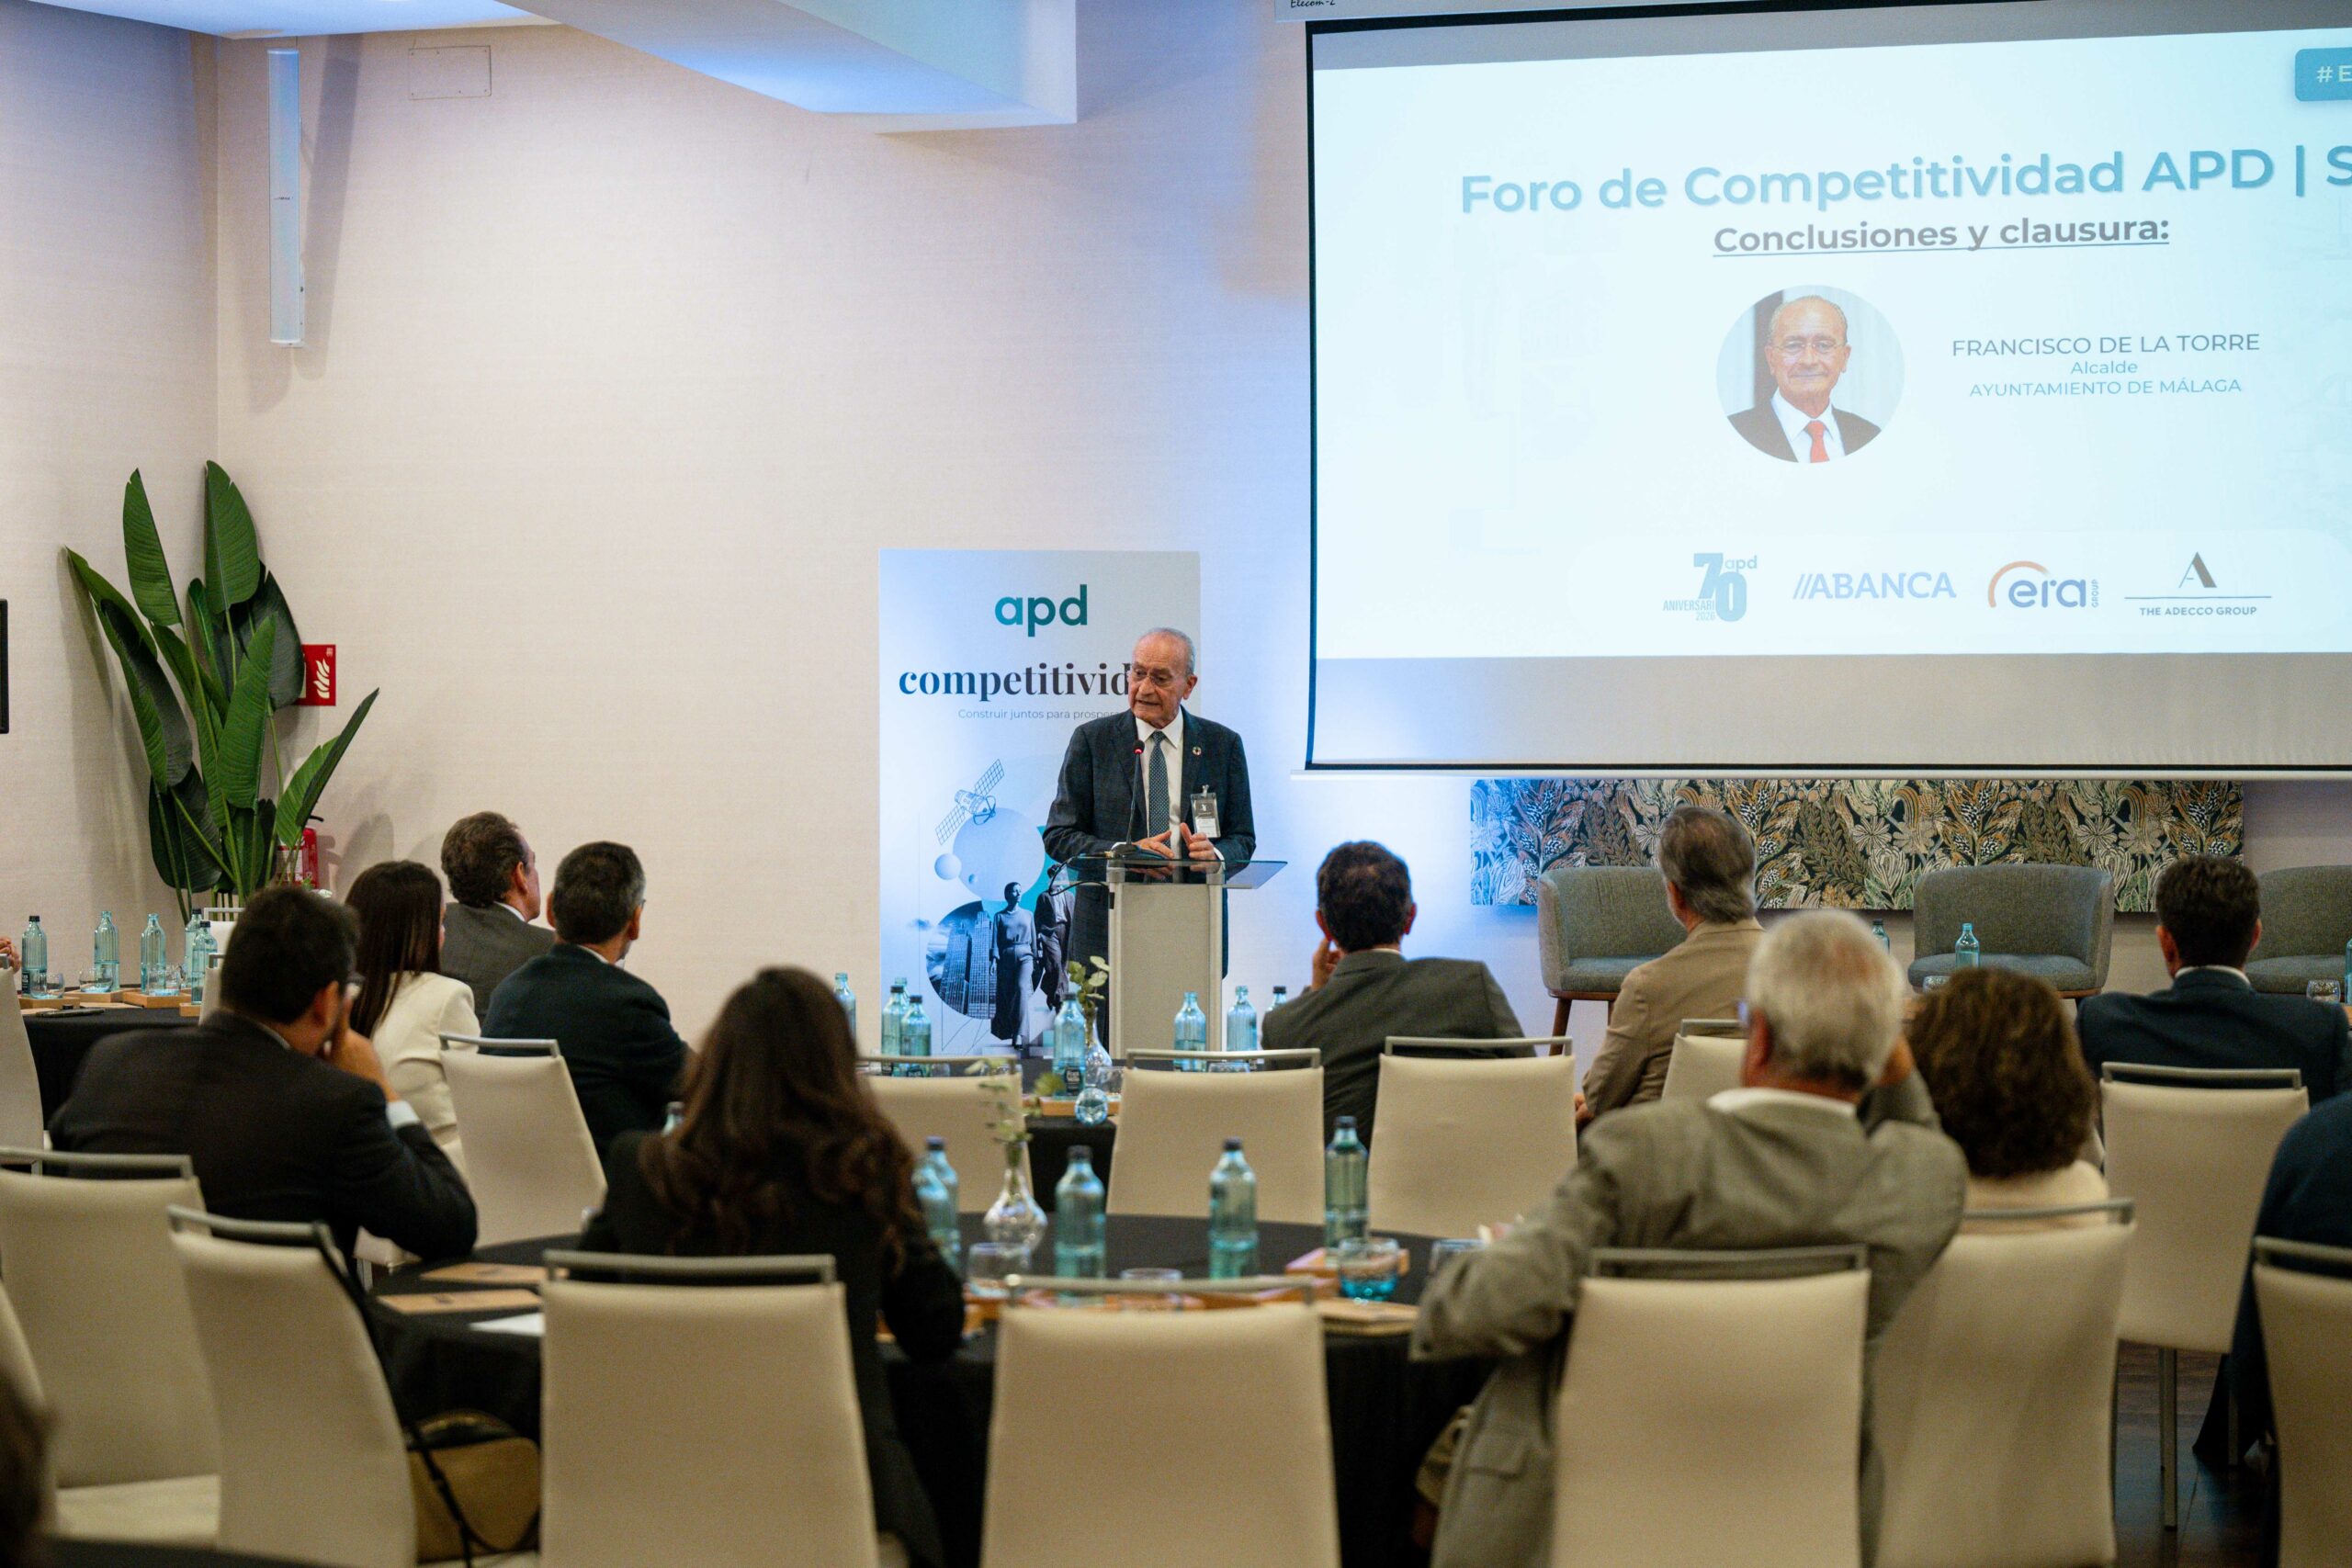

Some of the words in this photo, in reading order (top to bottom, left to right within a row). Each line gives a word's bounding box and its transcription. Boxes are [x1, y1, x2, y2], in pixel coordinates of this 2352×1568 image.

[1462, 175, 1583, 214] Foro
[1599, 167, 1668, 209] de
[1684, 150, 2124, 212] Competitividad
[2141, 148, 2275, 192] APD
[1713, 220, 1957, 253] Conclusiones
[1967, 225, 1990, 251] y
[1999, 217, 2170, 244] clausura:
[1952, 337, 2092, 356] FRANCISCO
[2099, 336, 2132, 354] DE
[2141, 335, 2171, 353] LA
[2177, 333, 2260, 352] TORRE
[2070, 360, 2139, 375] Alcalde
[1969, 380, 2122, 397] AYUNTAMIENTO
[2127, 380, 2154, 394] DE
[2160, 377, 2243, 394] MÁLAGA
[1724, 555, 1758, 572] apd
[2007, 579, 2086, 608] era
[994, 583, 1088, 637] apd
[2139, 606, 2162, 616] THE
[2164, 606, 2214, 616] ADECCO
[2215, 606, 2257, 616] GROUP
[899, 662, 1130, 703] competitivid
[957, 708, 1009, 719] Construir
[1010, 709, 1045, 721] juntos
[1046, 711, 1070, 721] para
